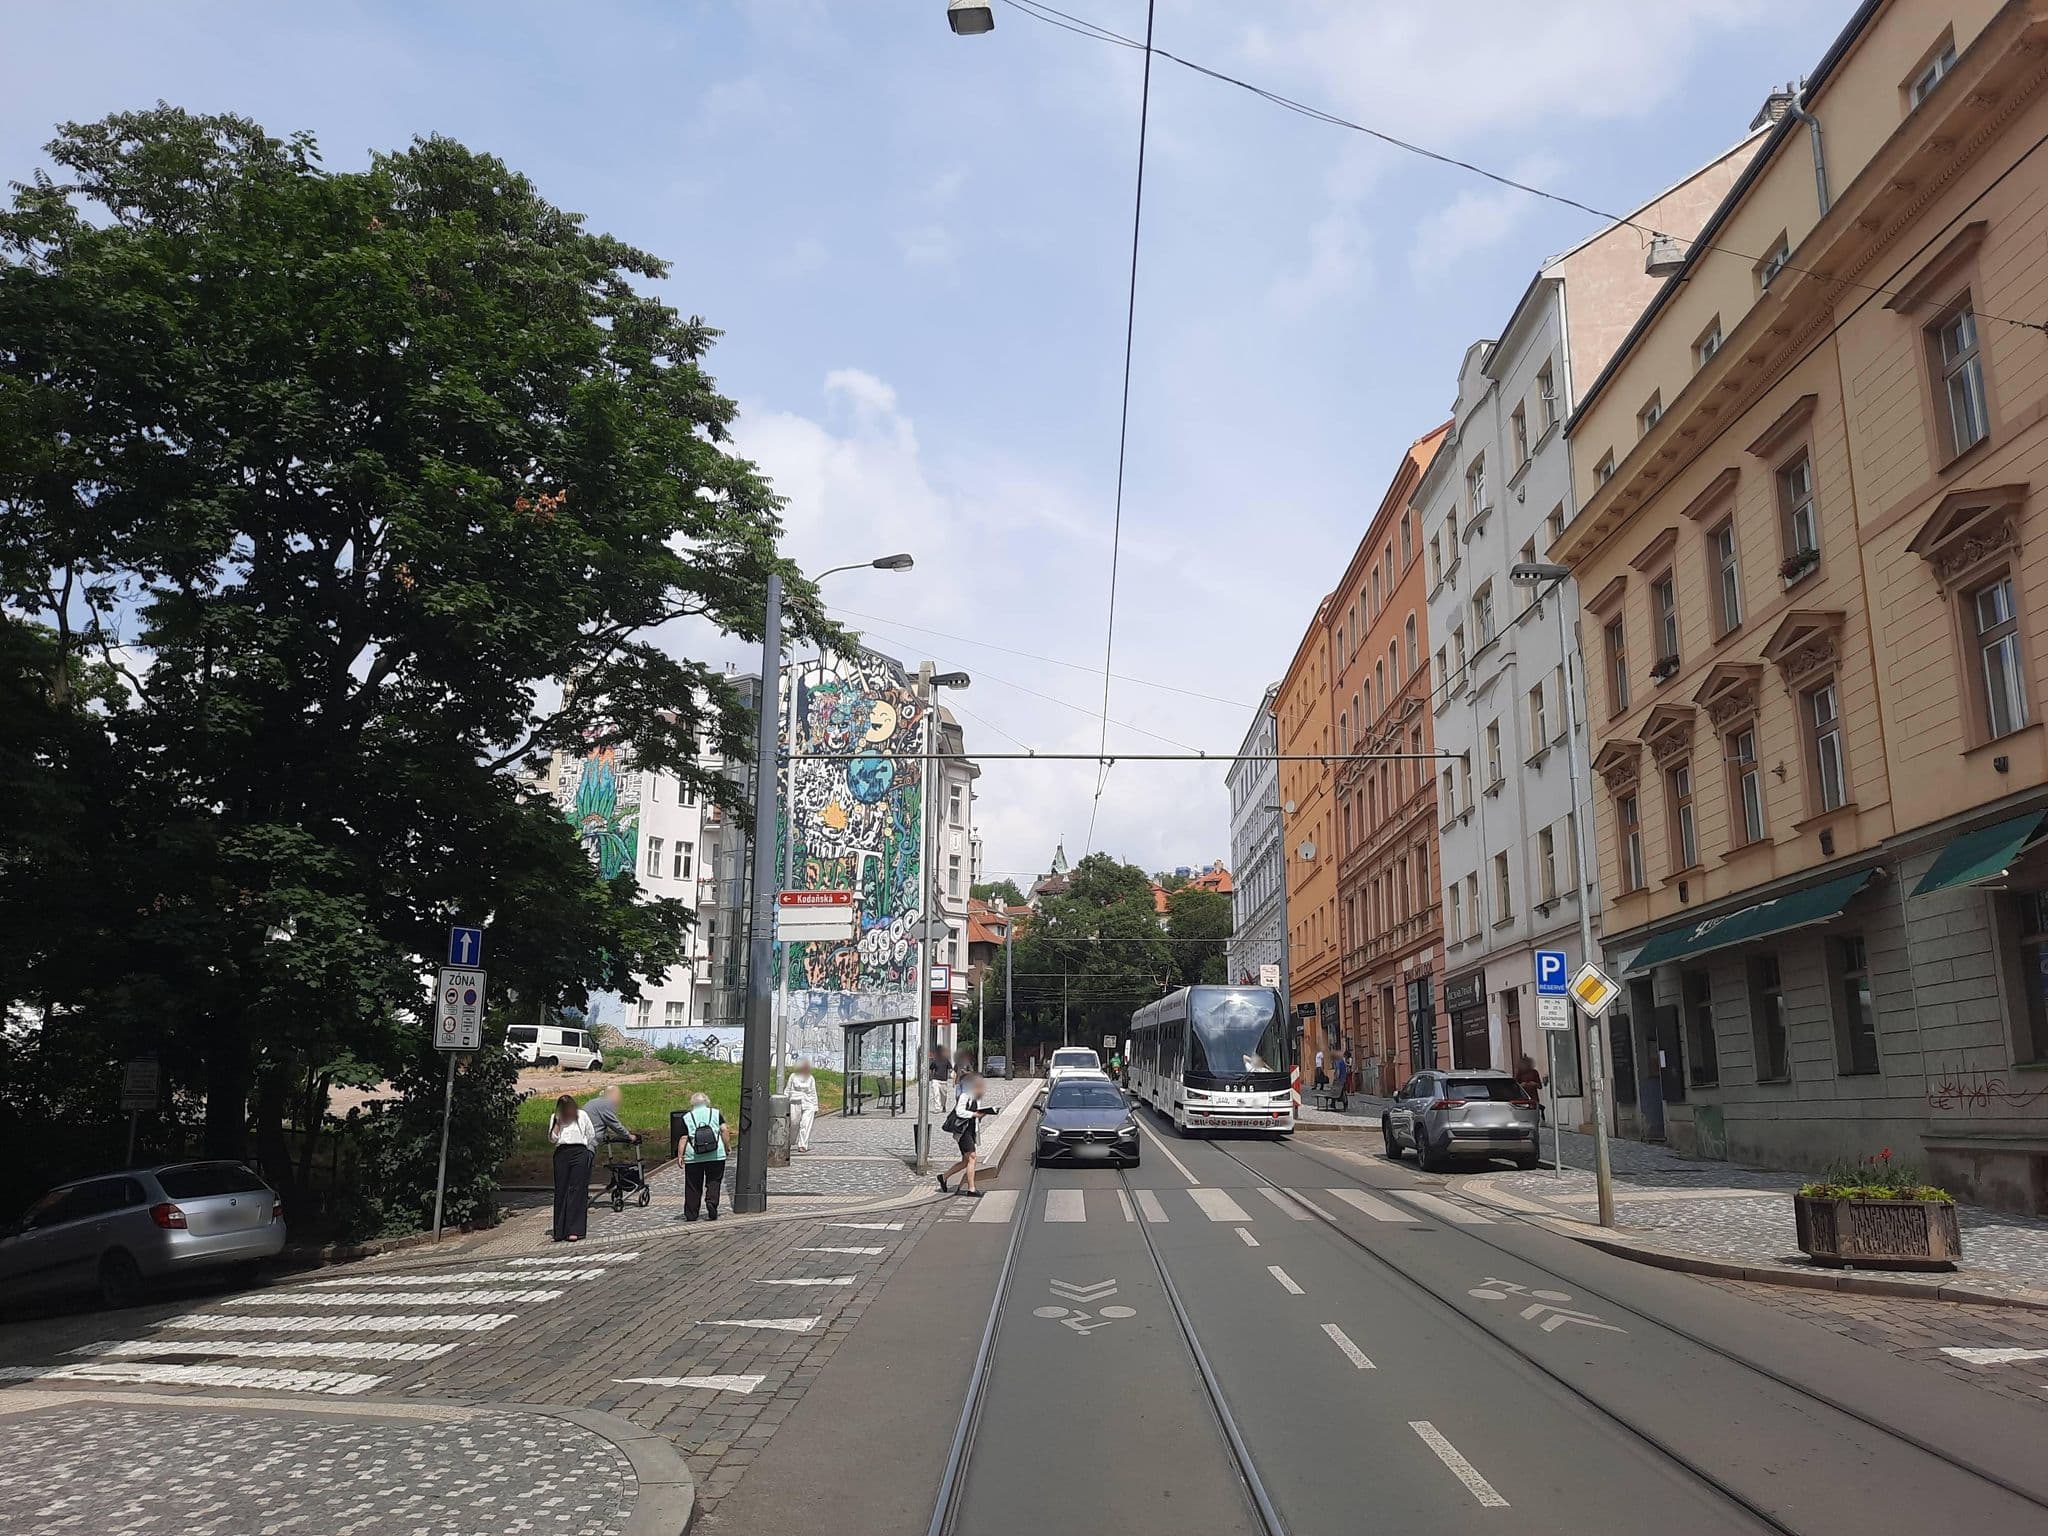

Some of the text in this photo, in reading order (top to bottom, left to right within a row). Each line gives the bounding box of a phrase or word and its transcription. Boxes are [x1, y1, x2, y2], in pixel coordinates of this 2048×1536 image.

[797, 893, 833, 903] Kodaňská
[1542, 956, 1560, 981] P
[449, 972, 476, 987] ZÓNA
